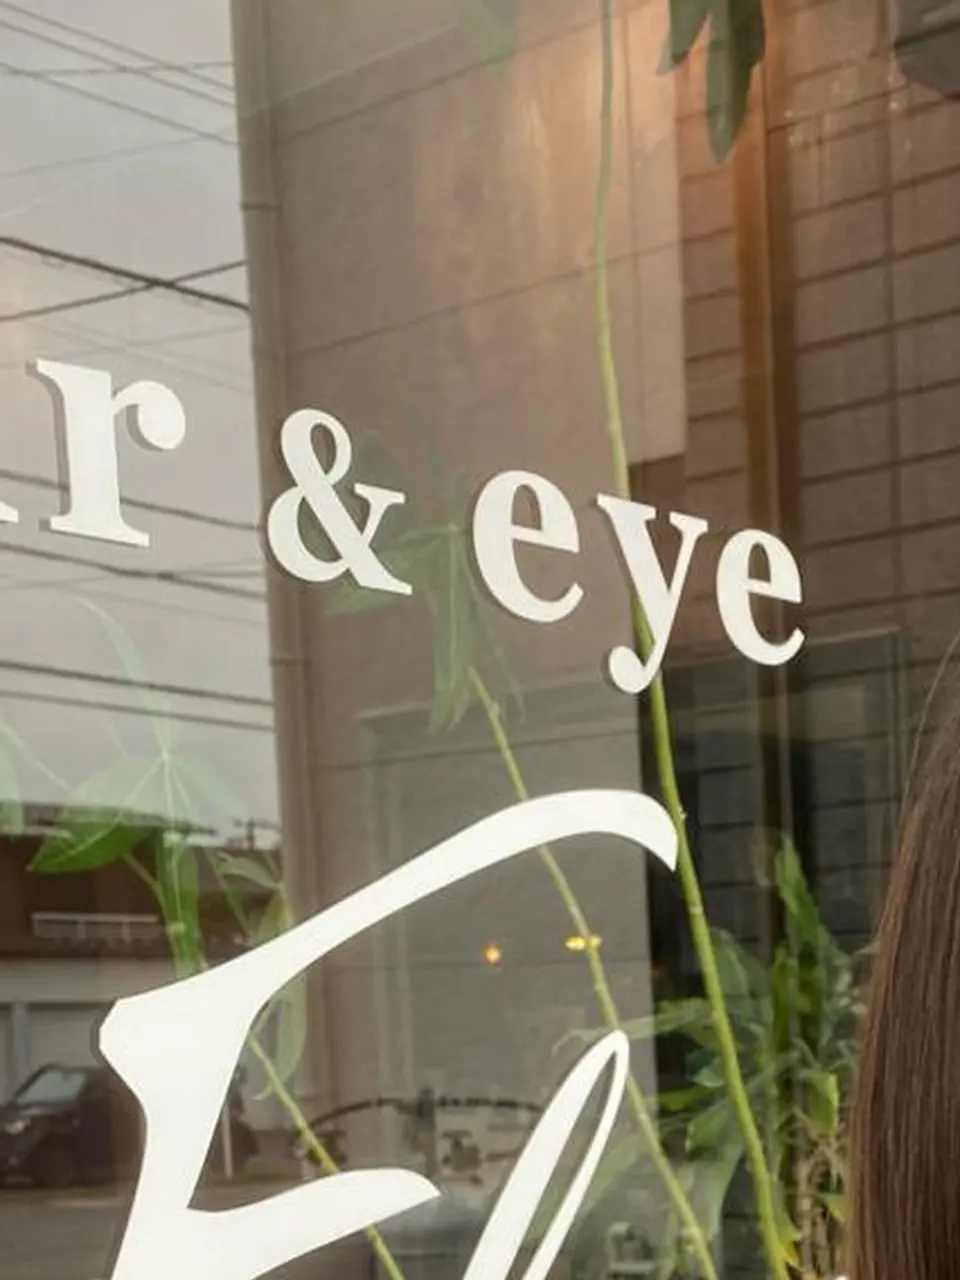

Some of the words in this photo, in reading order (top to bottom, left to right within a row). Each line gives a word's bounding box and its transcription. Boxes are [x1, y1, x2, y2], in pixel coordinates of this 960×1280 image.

[0, 358, 187, 547] r
[268, 409, 412, 594] &
[473, 470, 805, 694] eye
